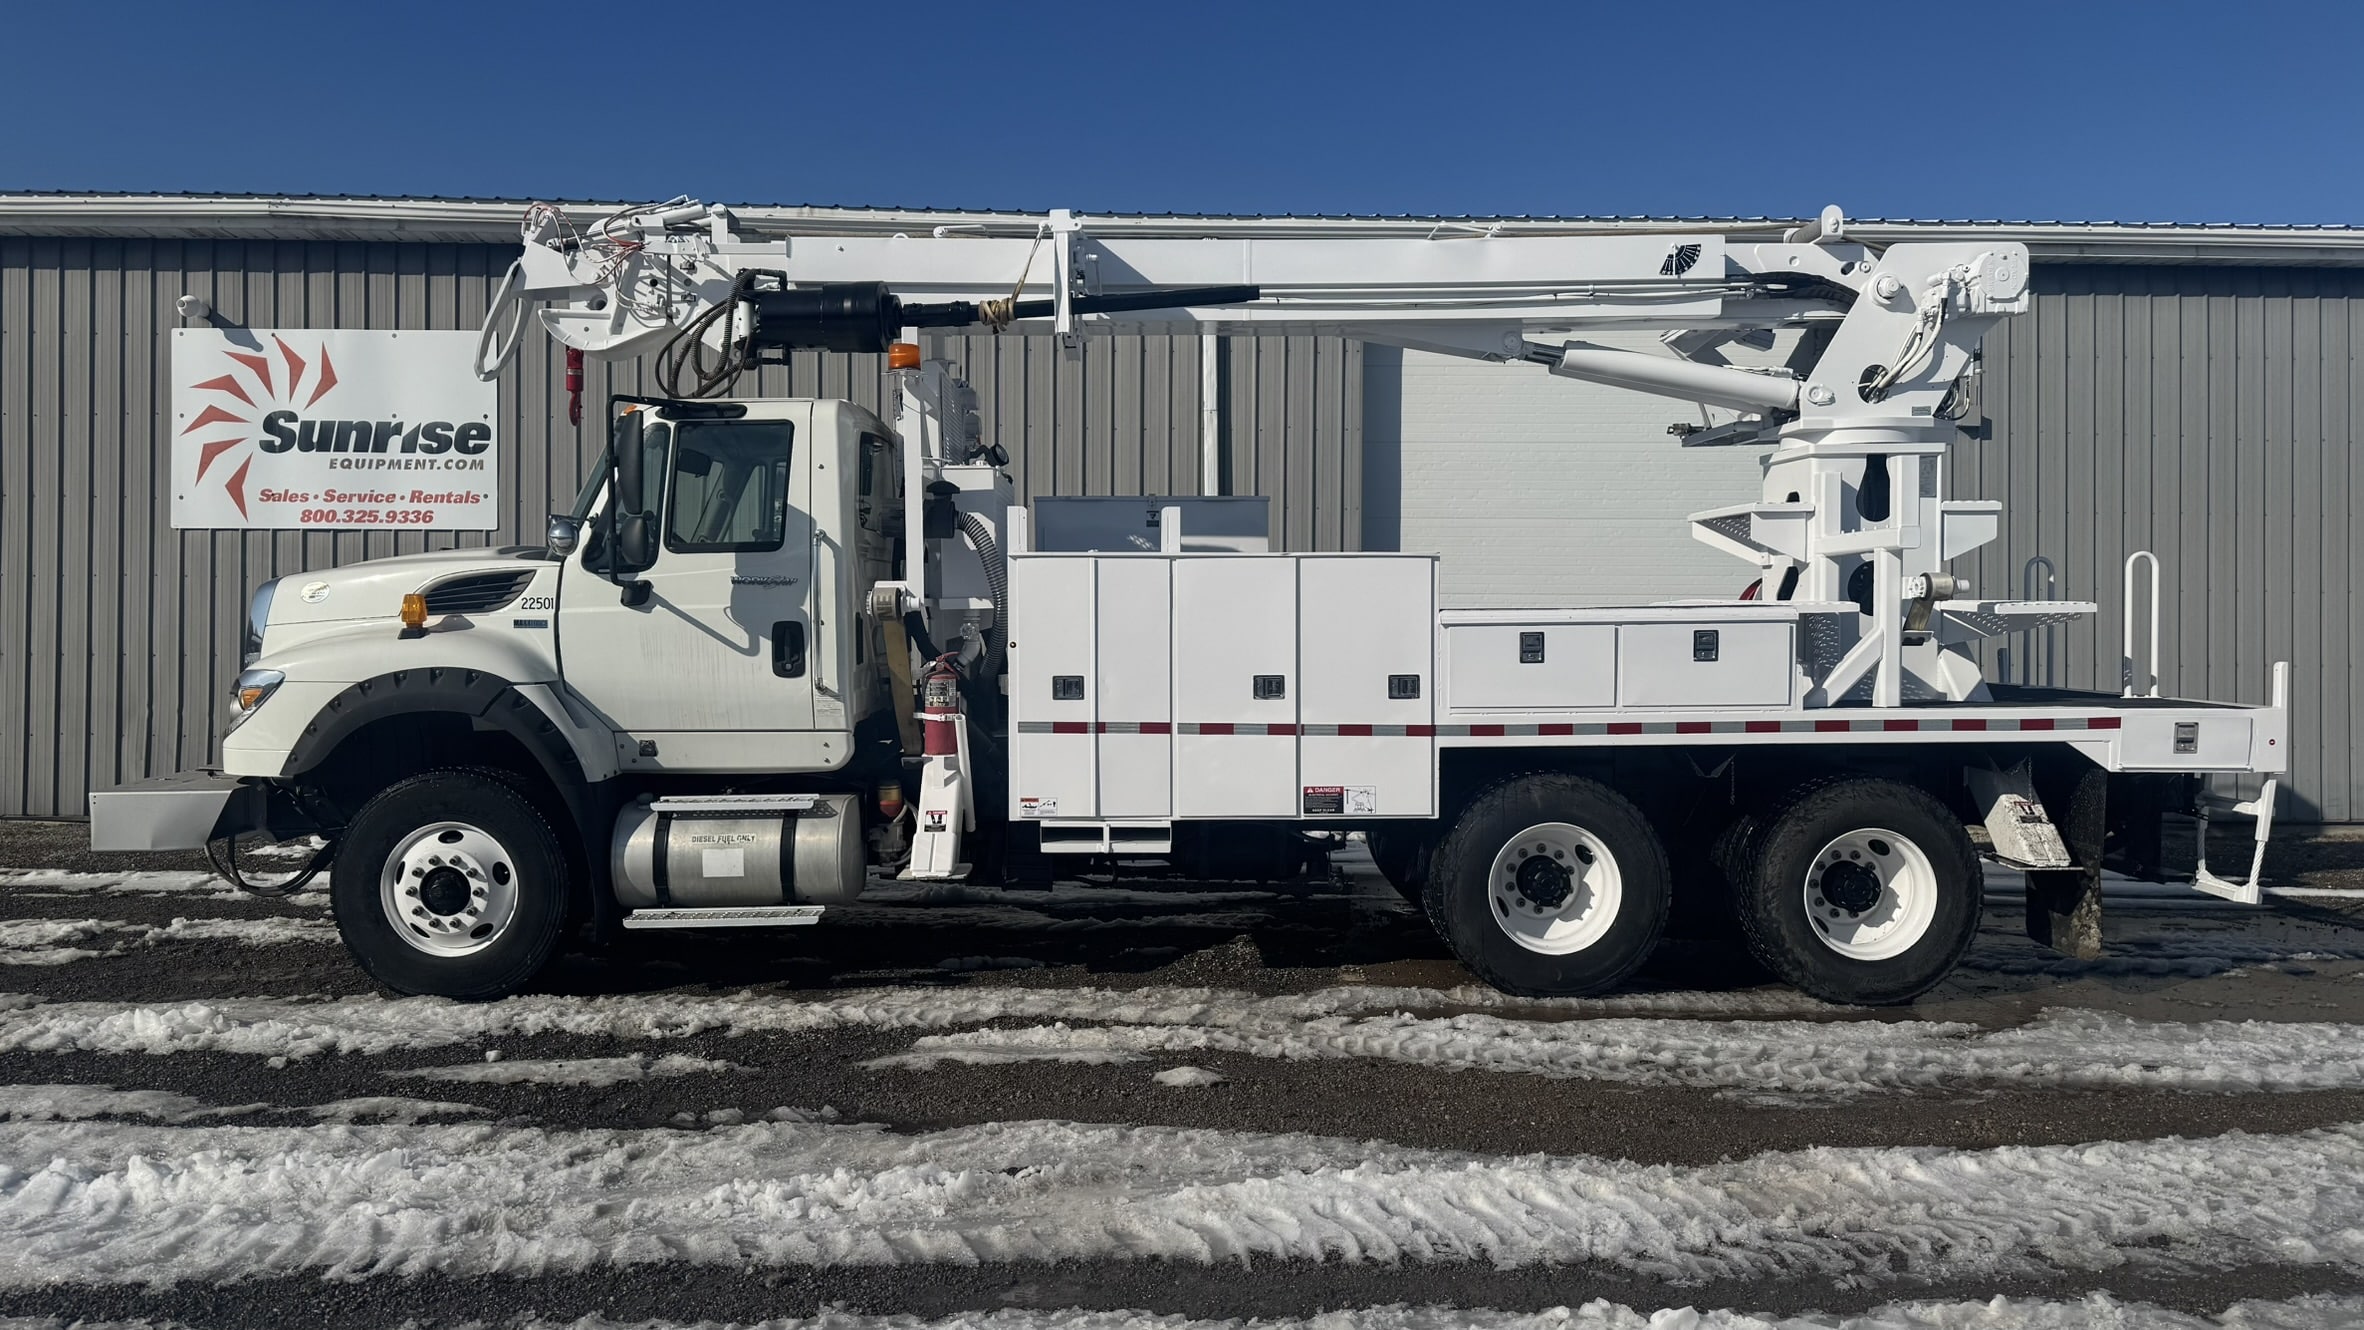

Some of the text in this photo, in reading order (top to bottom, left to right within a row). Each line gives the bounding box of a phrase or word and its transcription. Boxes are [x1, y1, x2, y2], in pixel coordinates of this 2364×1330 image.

[259, 410, 491, 454] Sunrise
[328, 458, 484, 471] EQUIPMENT.COM
[258, 488, 481, 504] Sales Service Rentals
[300, 509, 434, 524] 800.325.9336
[521, 597, 554, 610] 22501
[691, 835, 716, 843] DIESEL
